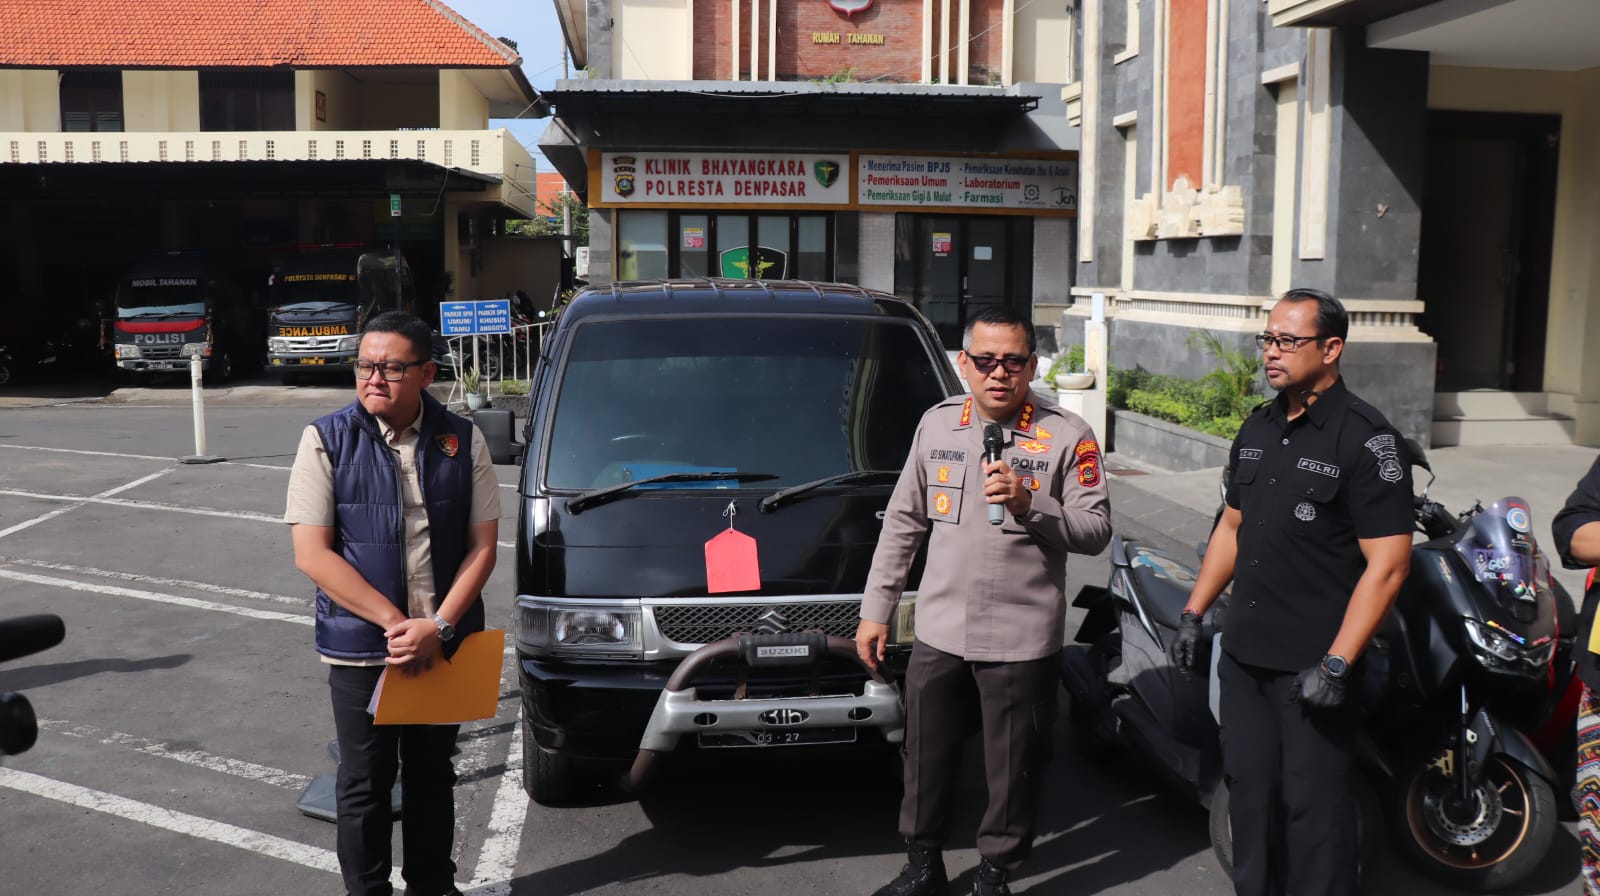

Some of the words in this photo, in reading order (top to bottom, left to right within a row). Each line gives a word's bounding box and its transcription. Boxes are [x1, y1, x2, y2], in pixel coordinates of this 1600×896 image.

[812, 32, 840, 44] RUMAH
[847, 33, 885, 45] TAHANAN
[645, 159, 691, 175] KLINIK
[702, 159, 807, 177] BHAYANGKARA
[867, 160, 901, 172] Menerima
[902, 160, 925, 172] Pasien
[927, 161, 951, 173] BPJS
[867, 174, 919, 186] Pemeriksaan
[921, 175, 947, 187] Umum
[964, 177, 1020, 190] Laboratorium
[645, 179, 724, 197] POLRESTA
[735, 180, 806, 197] DENPASAR
[867, 189, 911, 200] Pemeriksaan
[912, 189, 926, 204] Gigi
[964, 191, 1004, 204] Farmasi
[159, 279, 197, 287] TAHANAN
[134, 333, 185, 344] POLISI
[1011, 456, 1049, 472] POLRI
[1301, 460, 1336, 475] POLRI
[760, 647, 807, 656] SUZUKI
